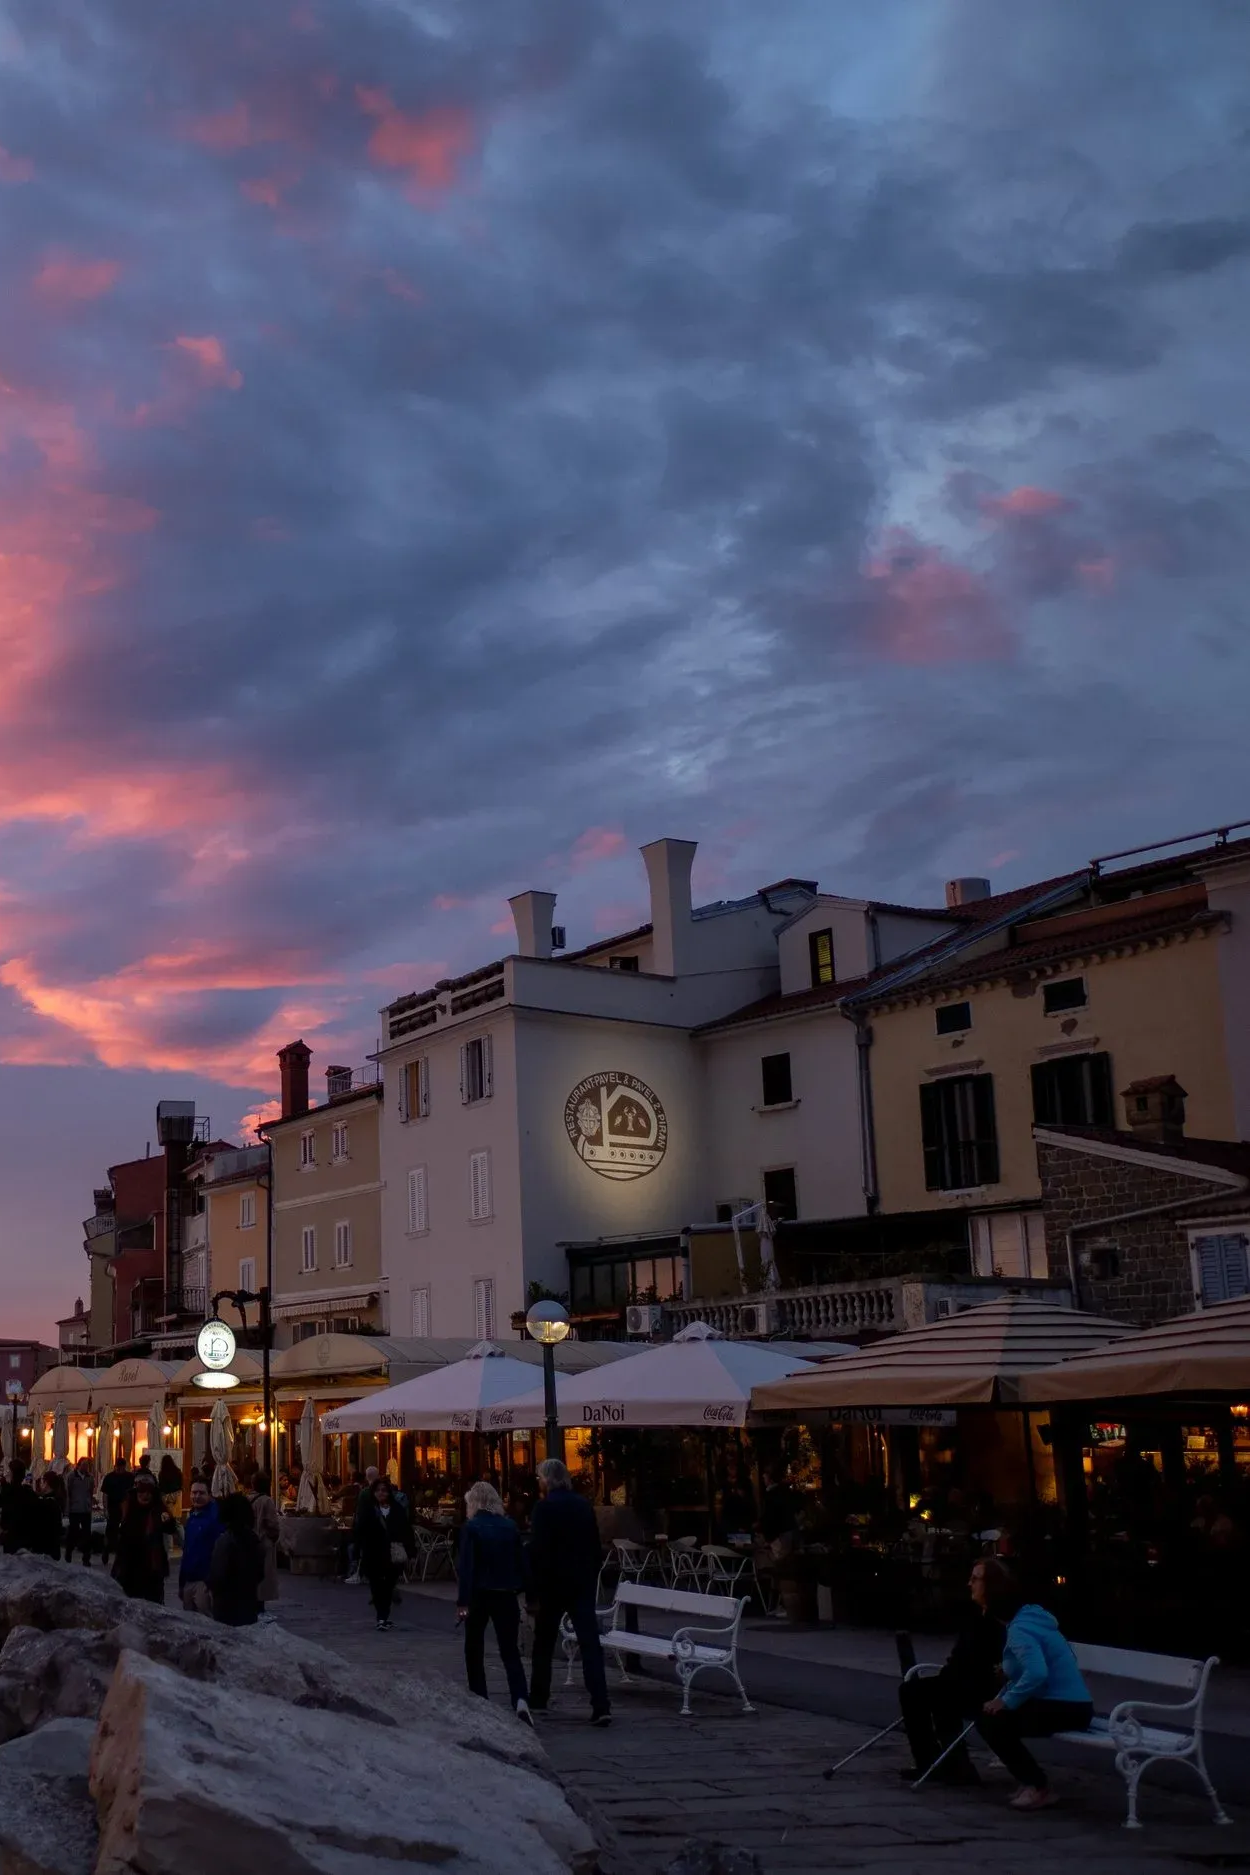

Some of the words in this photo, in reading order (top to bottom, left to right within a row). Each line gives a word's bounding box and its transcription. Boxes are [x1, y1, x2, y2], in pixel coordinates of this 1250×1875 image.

[623, 1075, 629, 1085] &
[631, 1080, 655, 1104] PAVEL
[380, 1411, 406, 1428] DaNoi
[583, 1404, 625, 1422] DaNoi
